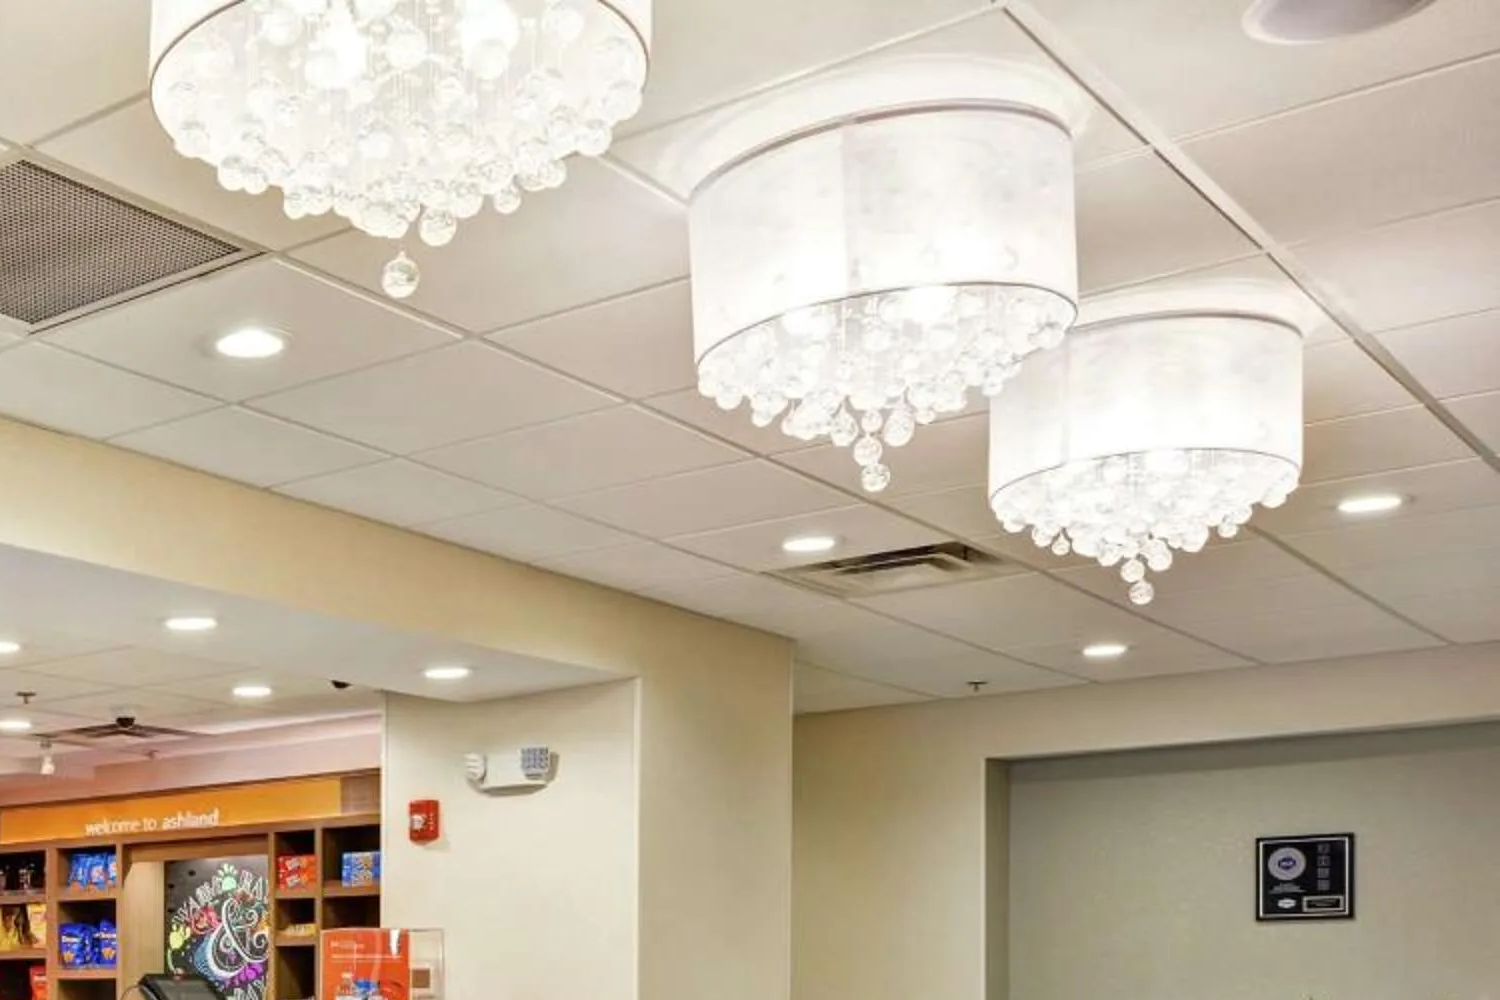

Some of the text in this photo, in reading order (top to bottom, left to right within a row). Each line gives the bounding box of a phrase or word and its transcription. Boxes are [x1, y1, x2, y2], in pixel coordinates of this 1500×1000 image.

[84, 808, 220, 837] welcome to ashland
